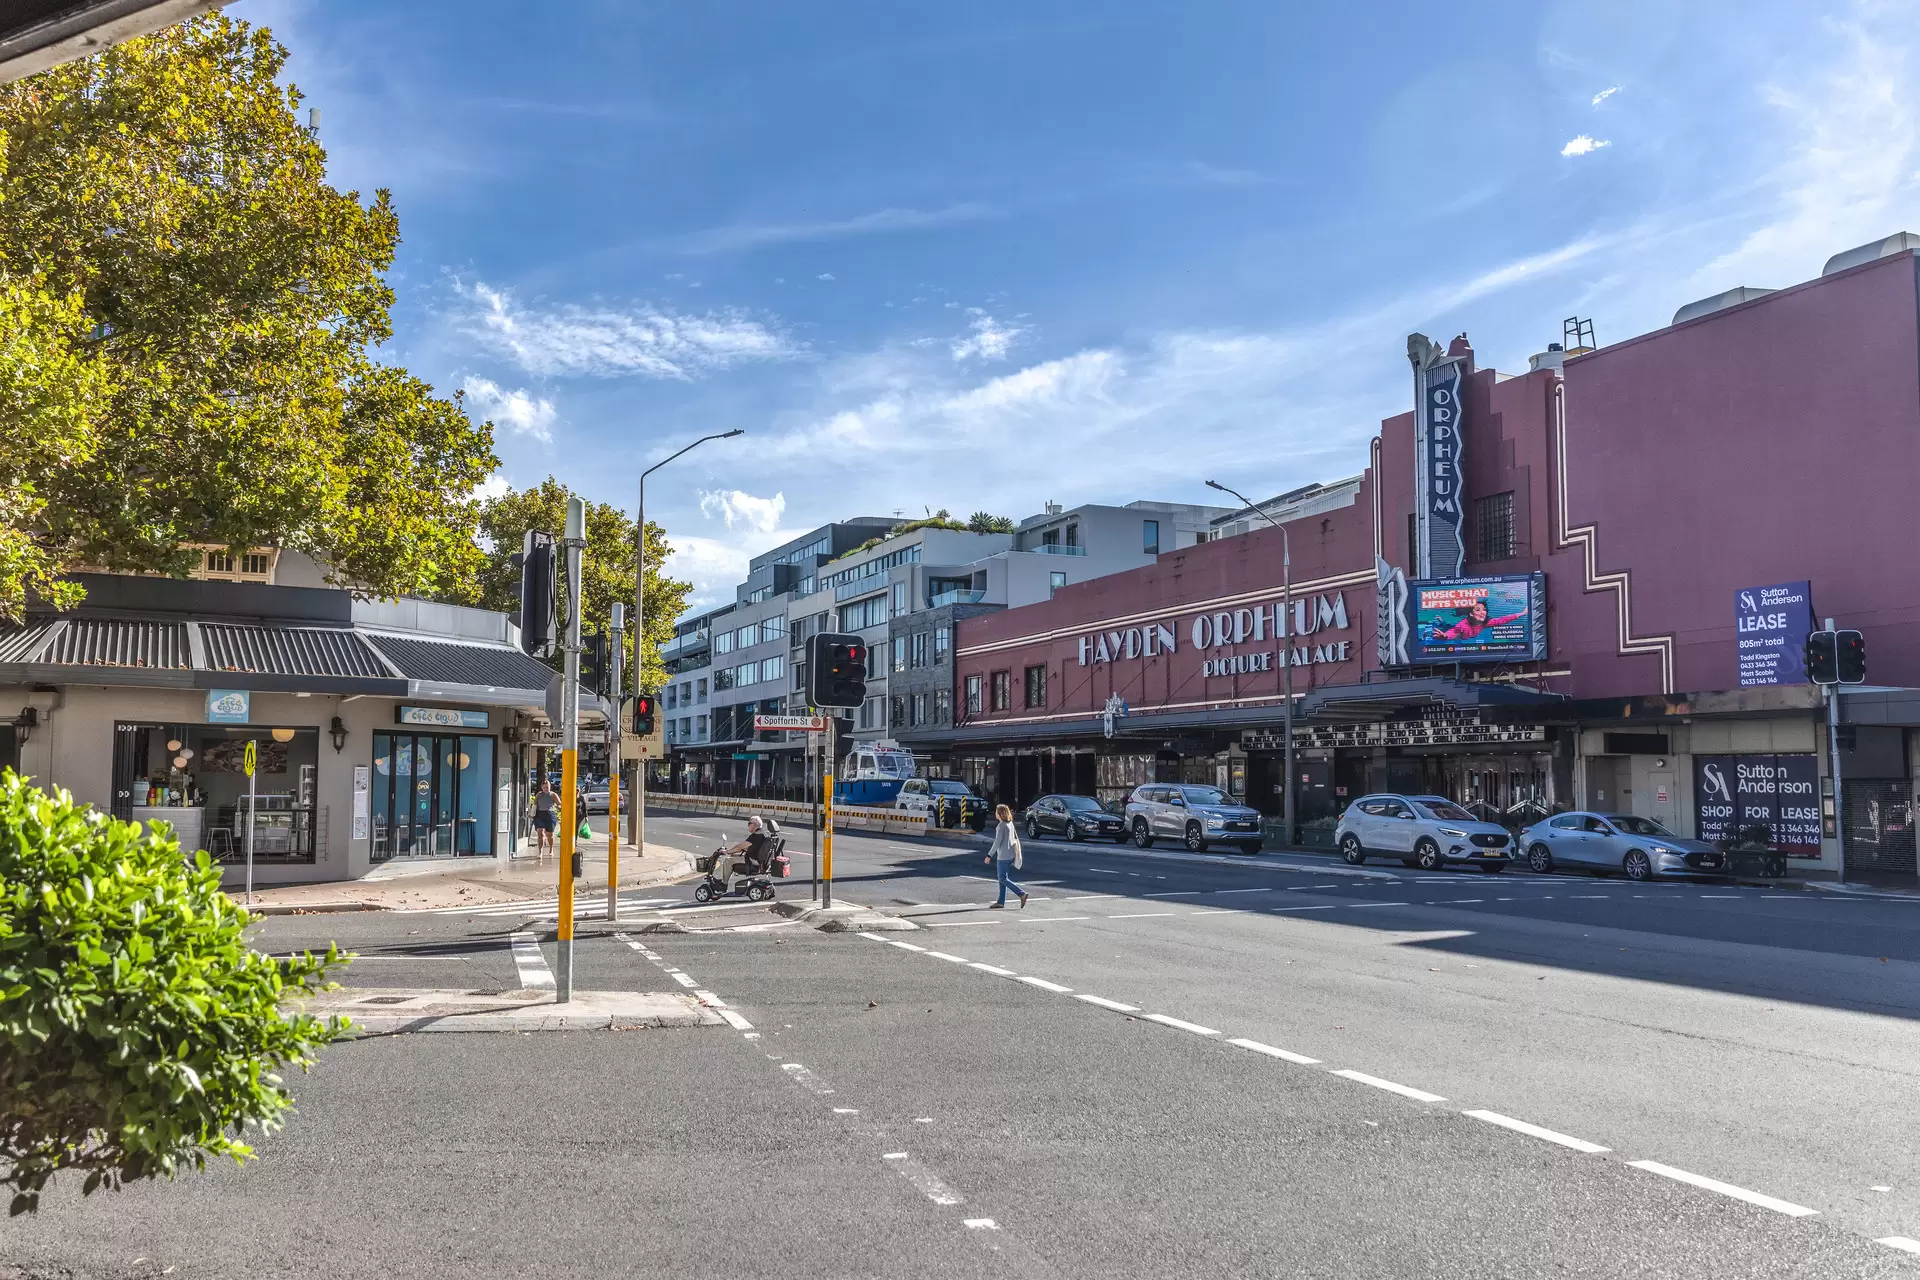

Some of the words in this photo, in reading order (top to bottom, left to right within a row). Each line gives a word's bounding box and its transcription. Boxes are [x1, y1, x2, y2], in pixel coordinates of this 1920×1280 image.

[1434, 390, 1454, 513] ORPHEUM
[1440, 576, 1502, 585] www.orpheum.com.au
[1422, 590, 1456, 599] MUSIC
[1460, 589, 1487, 598] THAT
[1761, 588, 1788, 597] Sutton
[1422, 600, 1451, 608] LIFTS
[1454, 599, 1477, 607] YOU
[1761, 594, 1802, 606] Anderson
[1078, 620, 1176, 666] HAYDEN
[1192, 590, 1349, 650] ORPHEUM
[1739, 613, 1786, 632] LEASE
[1765, 637, 1784, 646] total
[1755, 653, 1780, 661] Kingston
[1203, 652, 1272, 678] PICTURE
[764, 716, 798, 725] Spofforth
[800, 717, 808, 725] St
[1456, 734, 1502, 742] SOUNDTRACK
[1702, 806, 1733, 817] SHOP
[1745, 807, 1769, 818] FOR
[1782, 808, 1819, 819] LEASE
[1702, 822, 1721, 830] Todd
[1788, 825, 1802, 833] 346
[1804, 825, 1820, 834] 346
[1702, 832, 1720, 840] Matt
[1788, 835, 1802, 844] 146
[1805, 836, 1818, 844] 146
